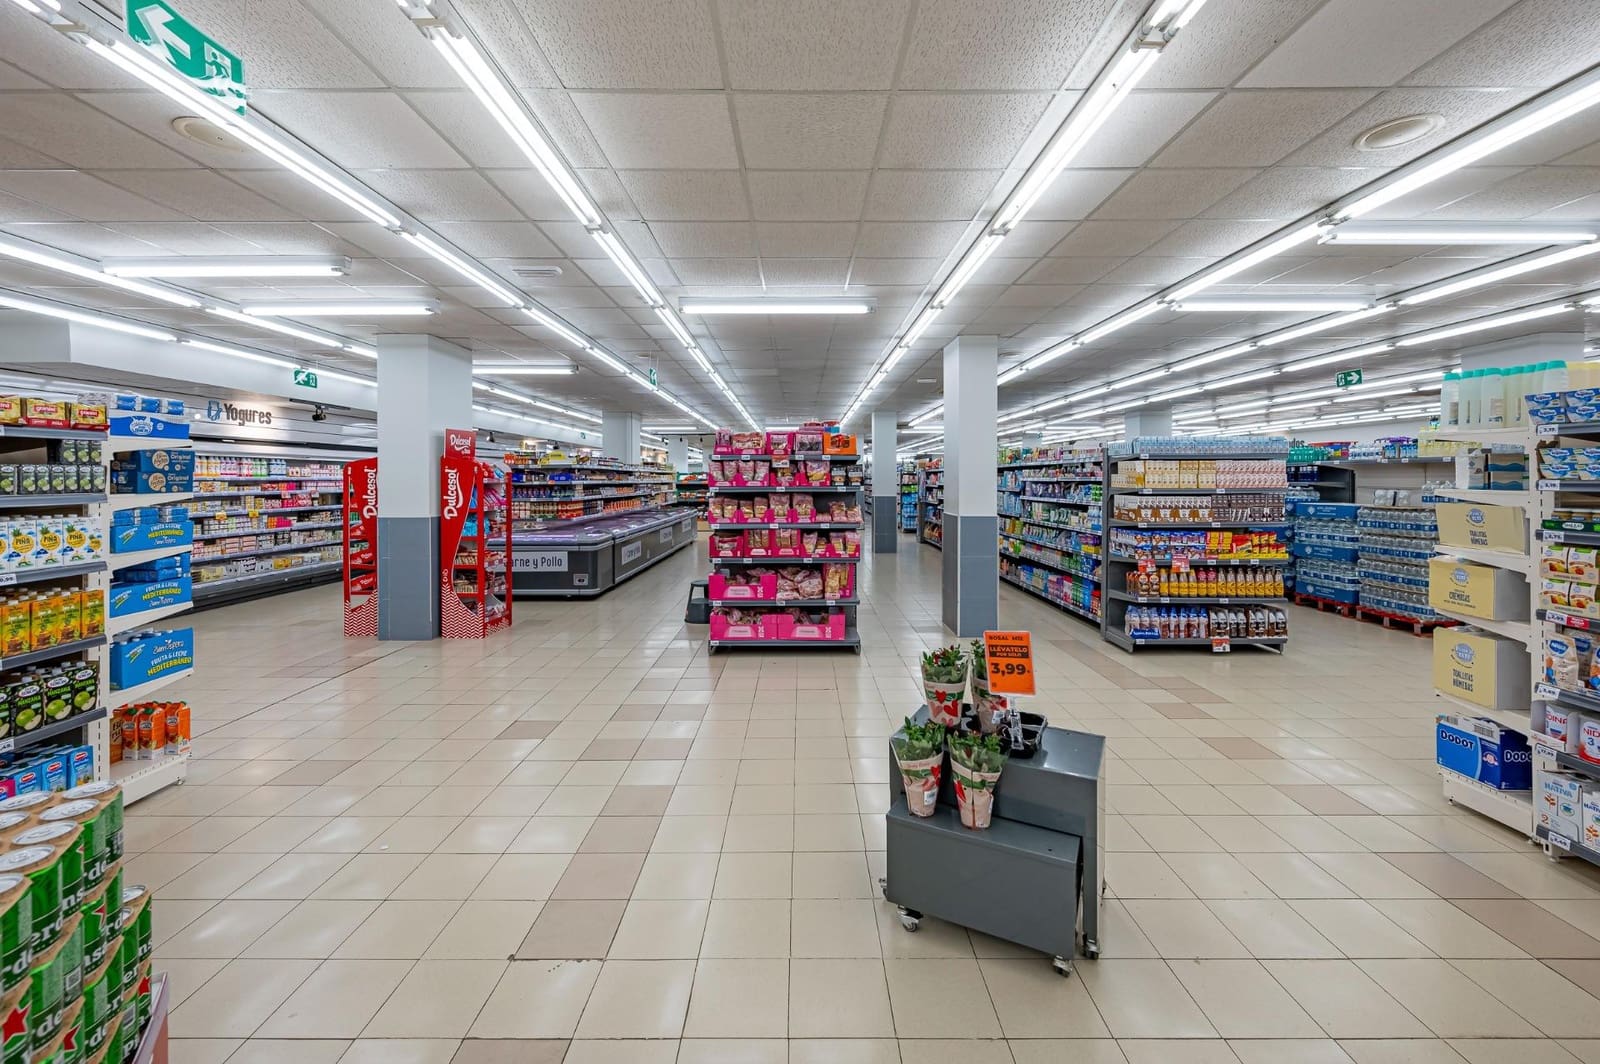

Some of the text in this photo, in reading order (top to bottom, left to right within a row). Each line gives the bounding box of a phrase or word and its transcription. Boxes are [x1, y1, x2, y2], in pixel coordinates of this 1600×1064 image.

[224, 403, 272, 426] Yogures
[362, 467, 377, 519] Dulcesol
[443, 467, 458, 520] Dulcesol
[505, 556, 563, 569] rne y Pollo
[991, 662, 1027, 677] 3,99
[1583, 727, 1600, 738] NID
[1440, 730, 1474, 750] DODOT
[1588, 737, 1595, 746] 3
[1504, 750, 1532, 762] DODO
[1541, 813, 1549, 825] 2
